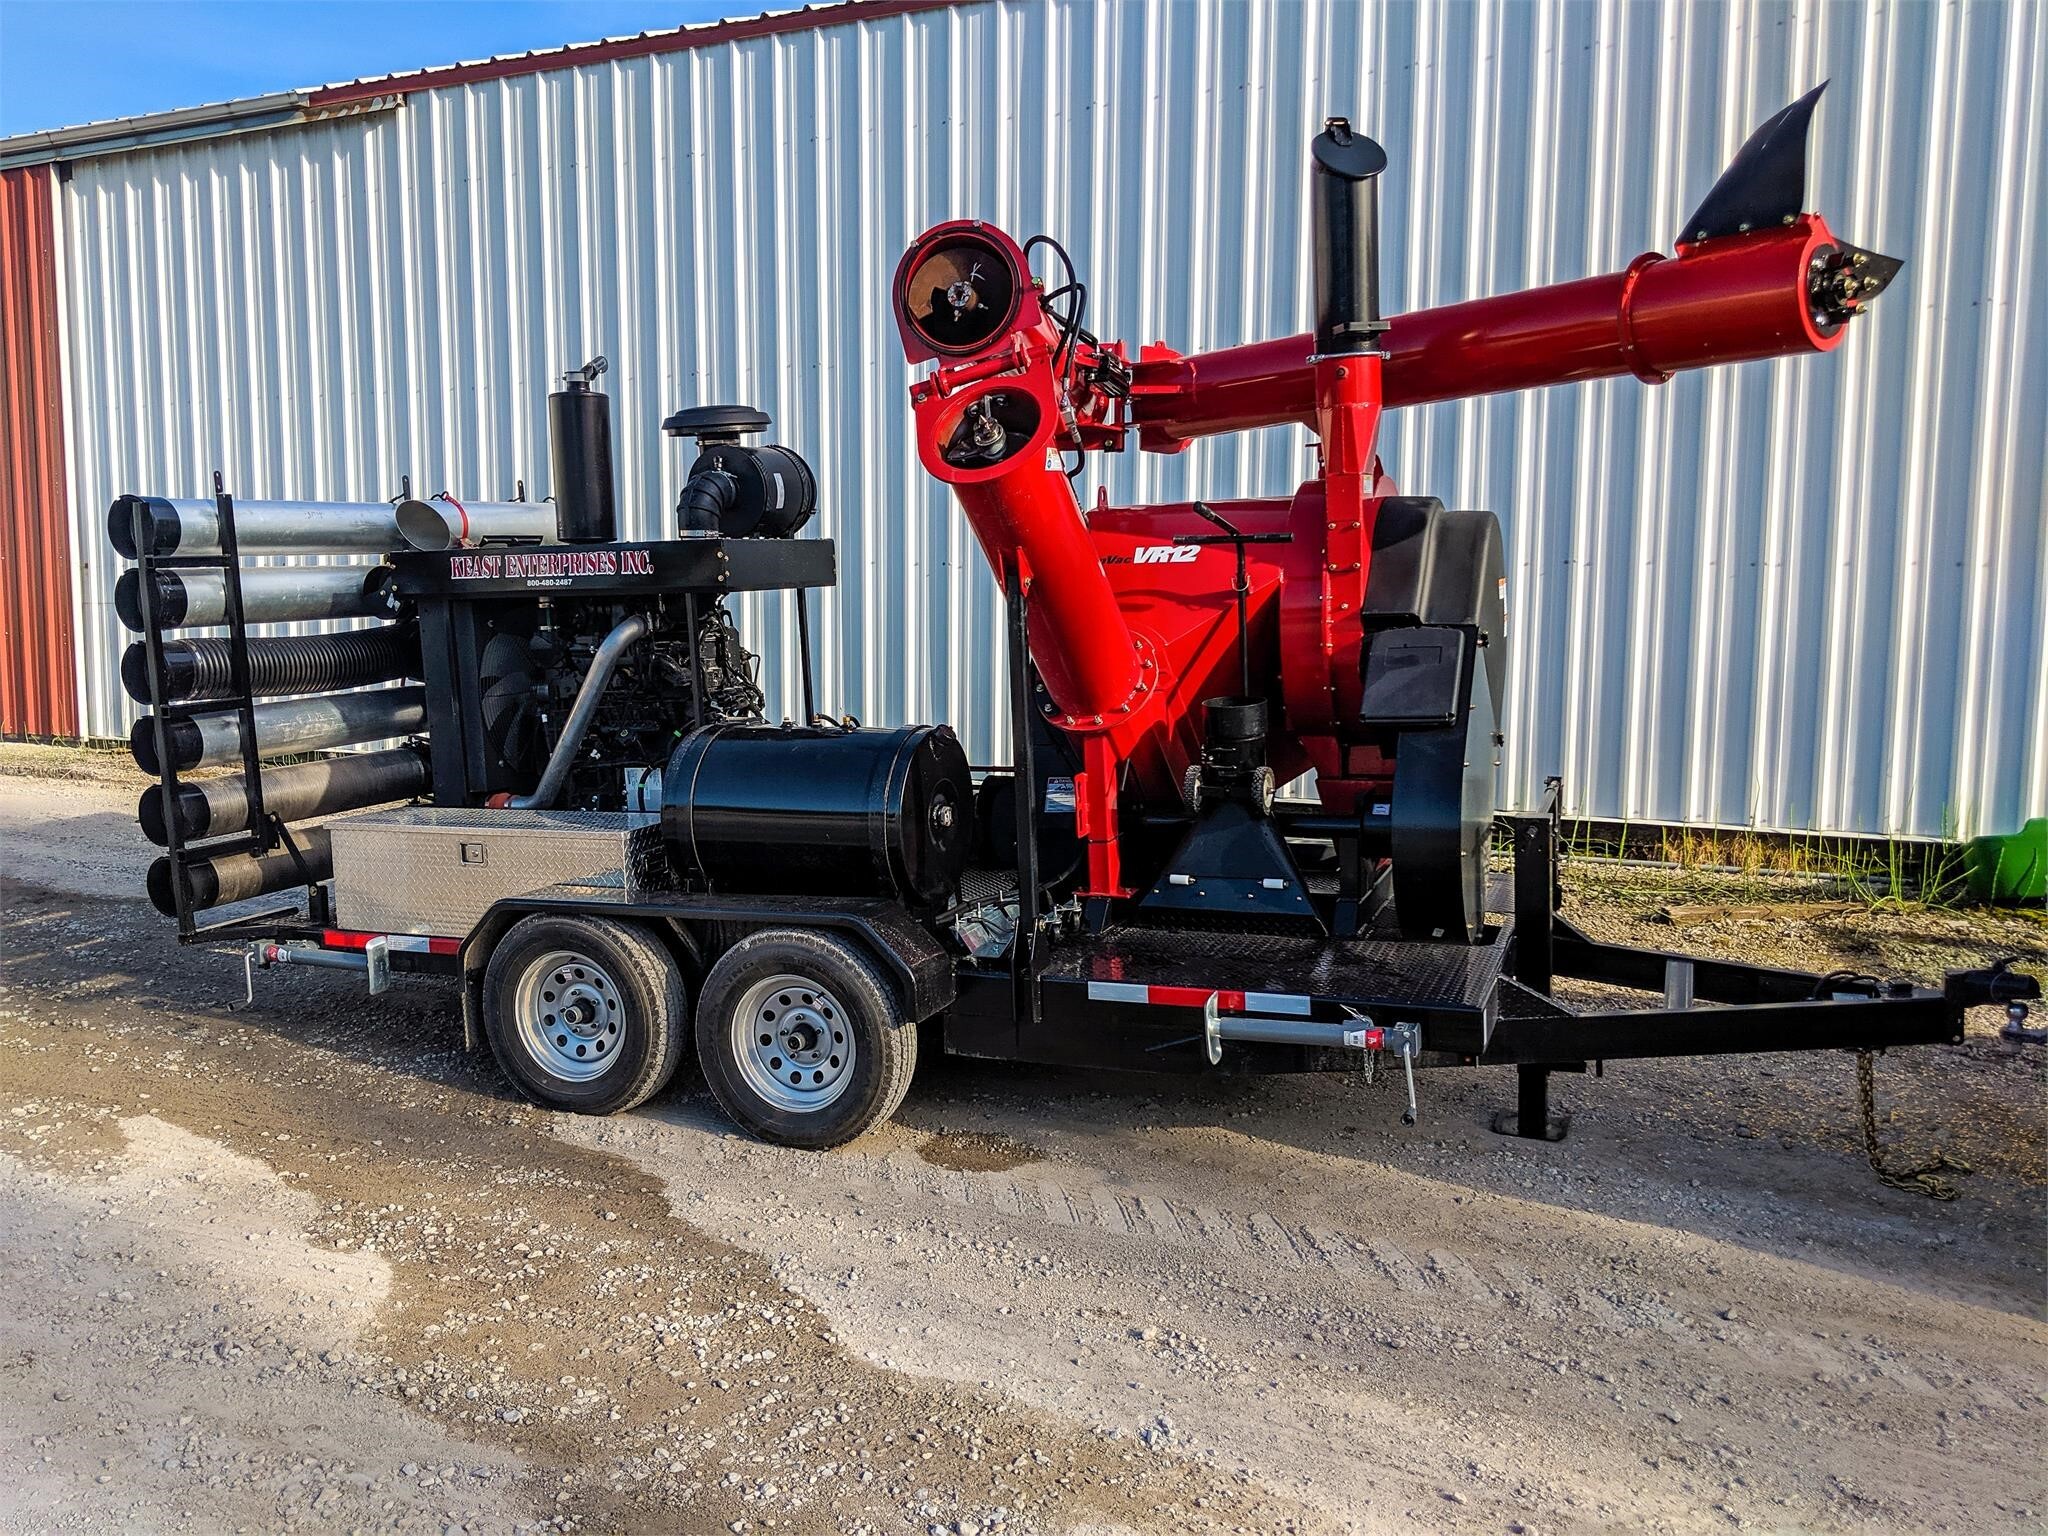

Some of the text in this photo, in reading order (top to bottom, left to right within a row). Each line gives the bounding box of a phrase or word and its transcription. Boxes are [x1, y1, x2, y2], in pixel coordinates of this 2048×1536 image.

[1133, 545, 1200, 564] VR12
[450, 550, 654, 579] KEAST ENTERPRISES INC.
[526, 579, 573, 587] 800-480-2487
